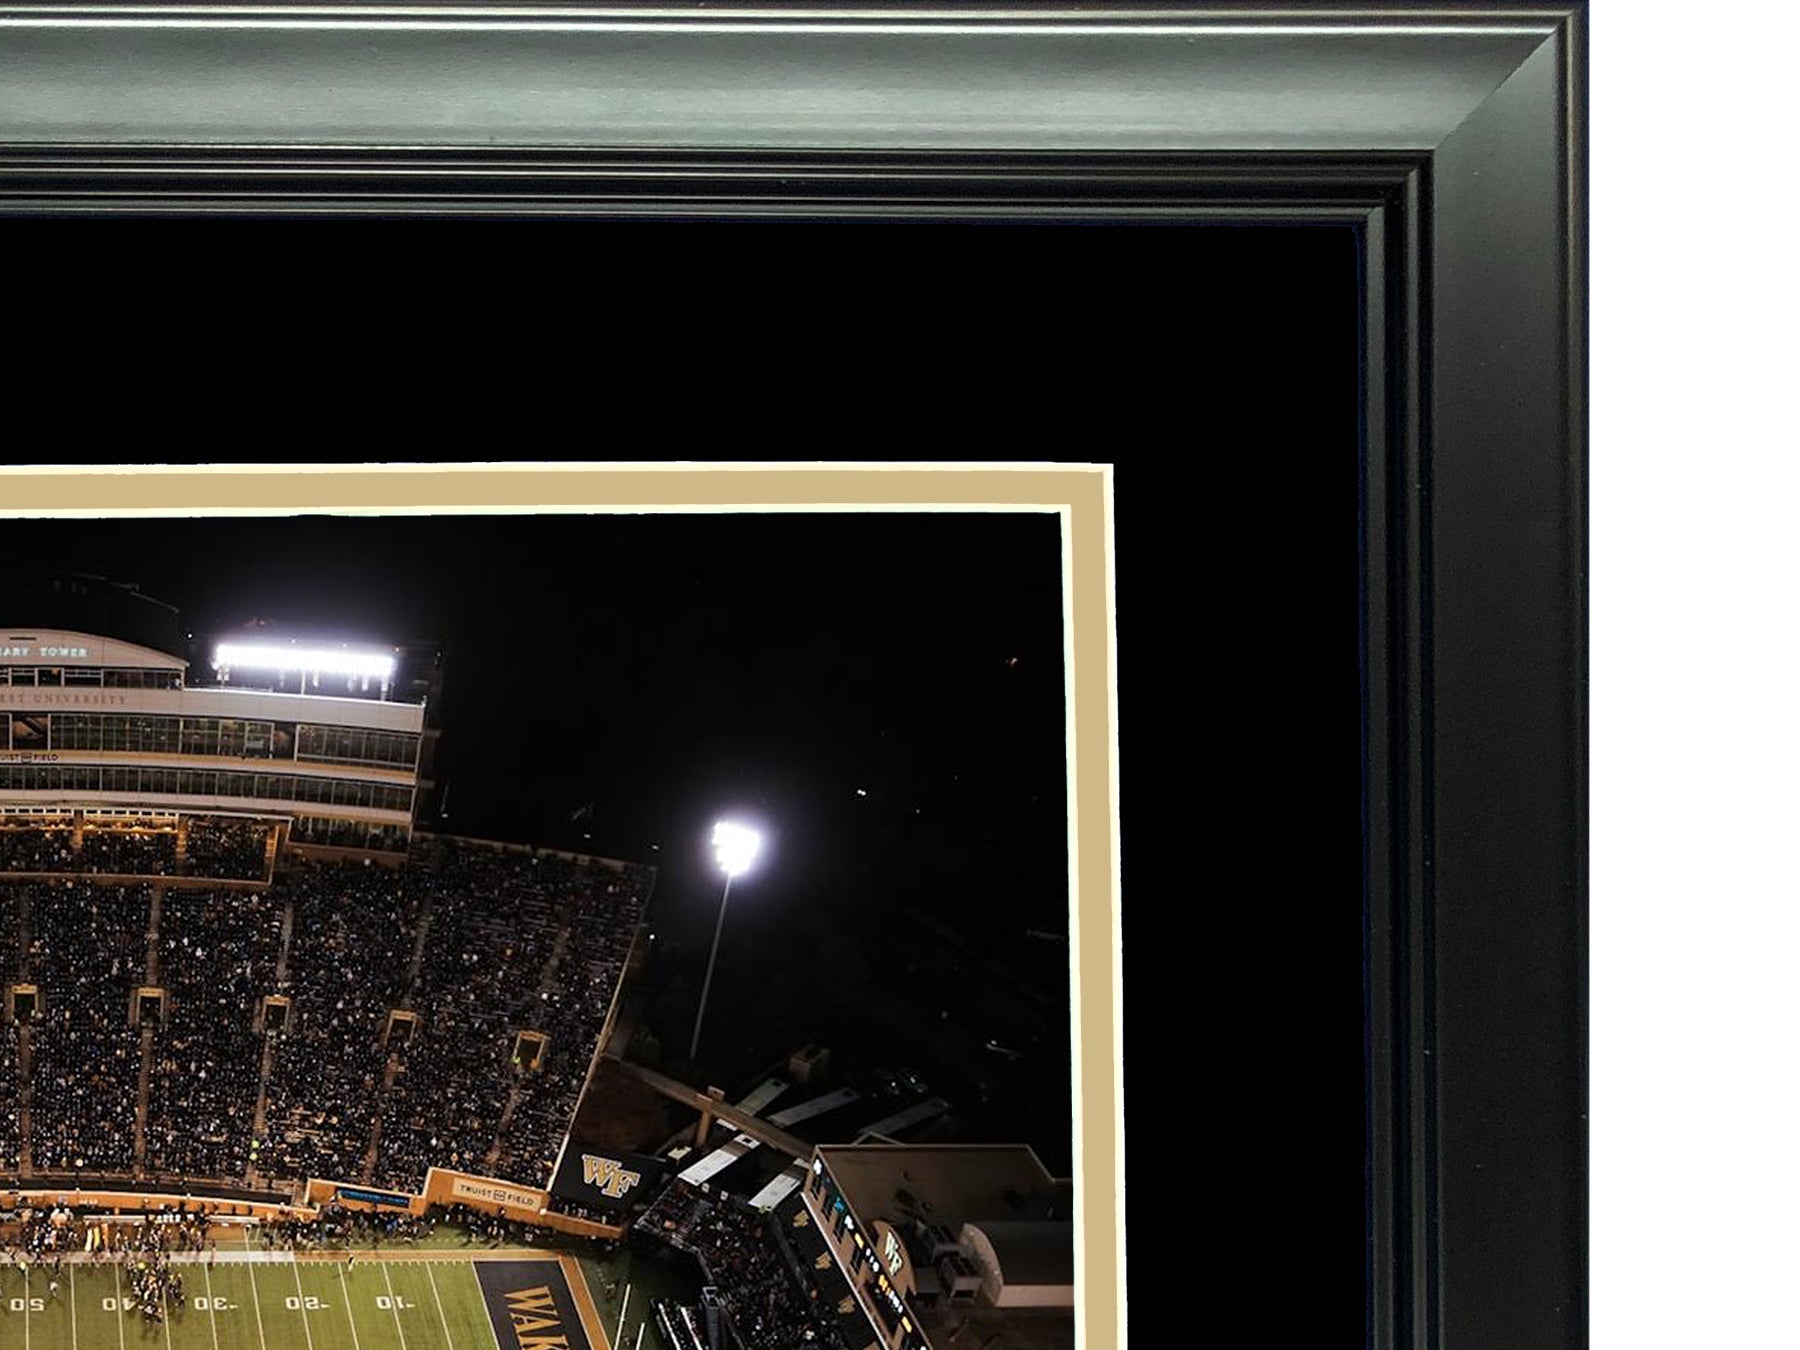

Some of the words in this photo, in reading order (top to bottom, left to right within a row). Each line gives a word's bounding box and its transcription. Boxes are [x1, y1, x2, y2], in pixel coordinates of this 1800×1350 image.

[40, 647, 88, 657] TOWER
[33, 695, 126, 705] UNIVERSITY
[581, 1153, 640, 1199] WF
[459, 1184, 493, 1198] TRUIST
[507, 1192, 534, 1206] FIELD
[10, 1298, 45, 1311] 50
[194, 1297, 229, 1311] 30
[286, 1297, 320, 1310] 20
[376, 1296, 405, 1310] 10
